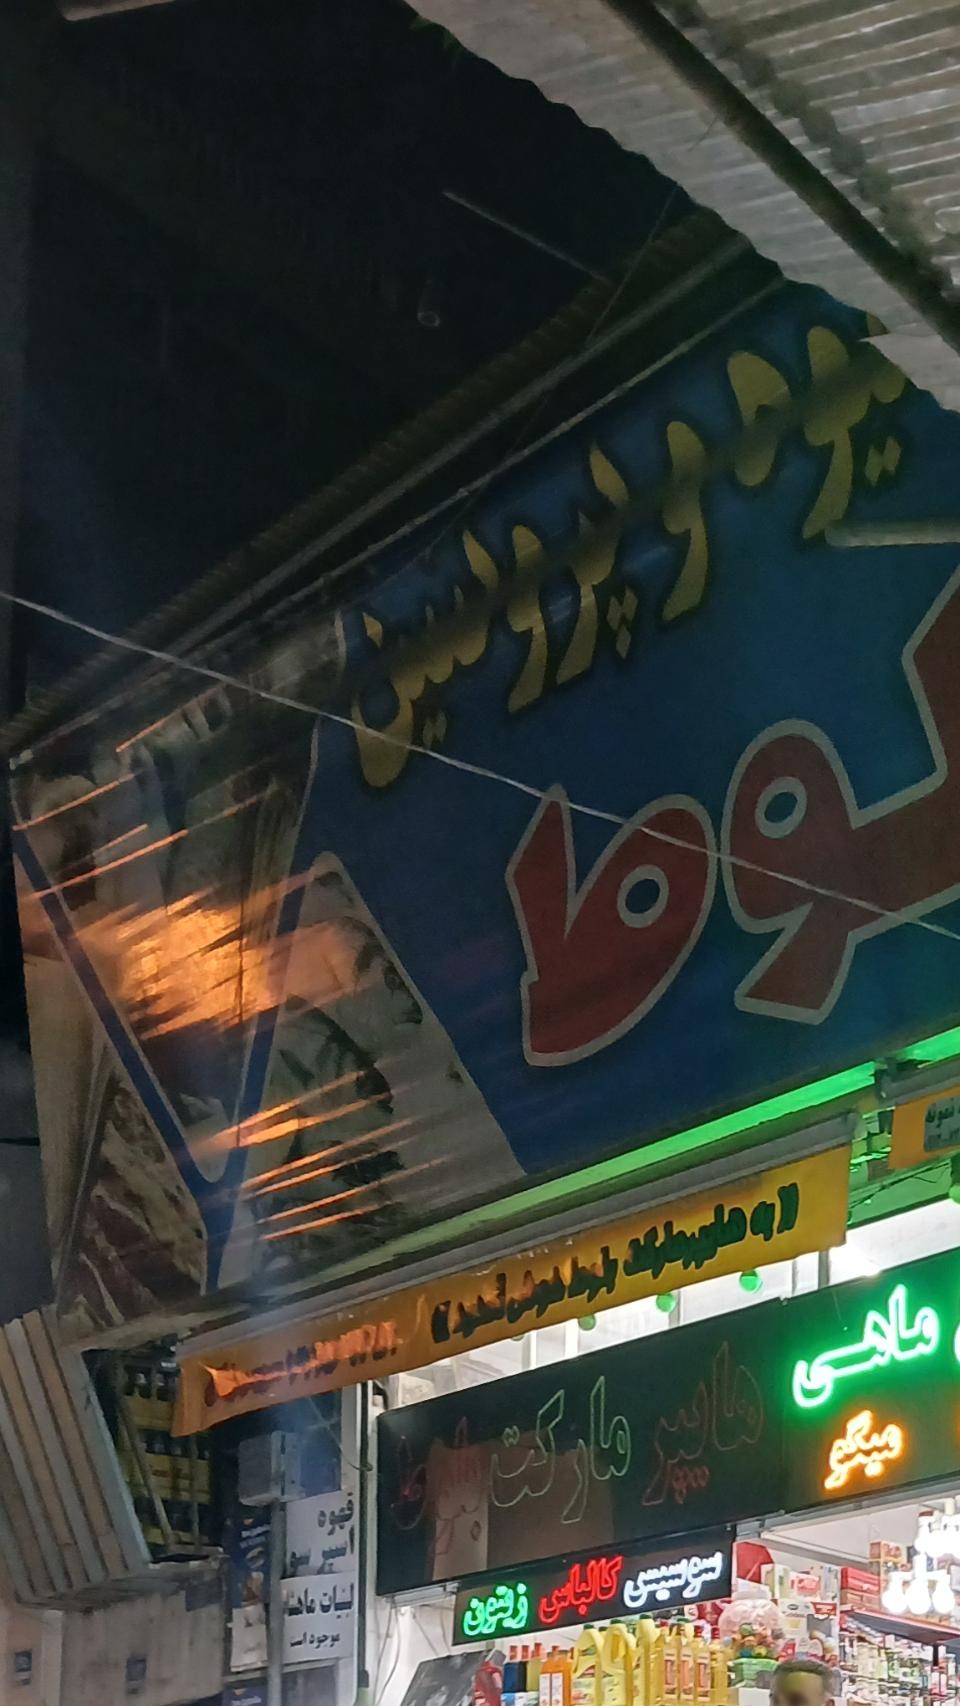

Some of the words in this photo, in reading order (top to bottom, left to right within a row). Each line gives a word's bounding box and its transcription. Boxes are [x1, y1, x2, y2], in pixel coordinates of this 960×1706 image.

[792, 1283, 938, 1407] ماهی
[490, 1375, 631, 1524] مارکت
[824, 1410, 902, 1489] میگو
[318, 1492, 353, 1536] قهوه
[320, 1583, 354, 1619] لبنیات
[538, 1554, 624, 1621] کالباس
[623, 1549, 723, 1607] سوسیس
[461, 1581, 529, 1636] زیتون
[309, 1633, 340, 1648] موجود
